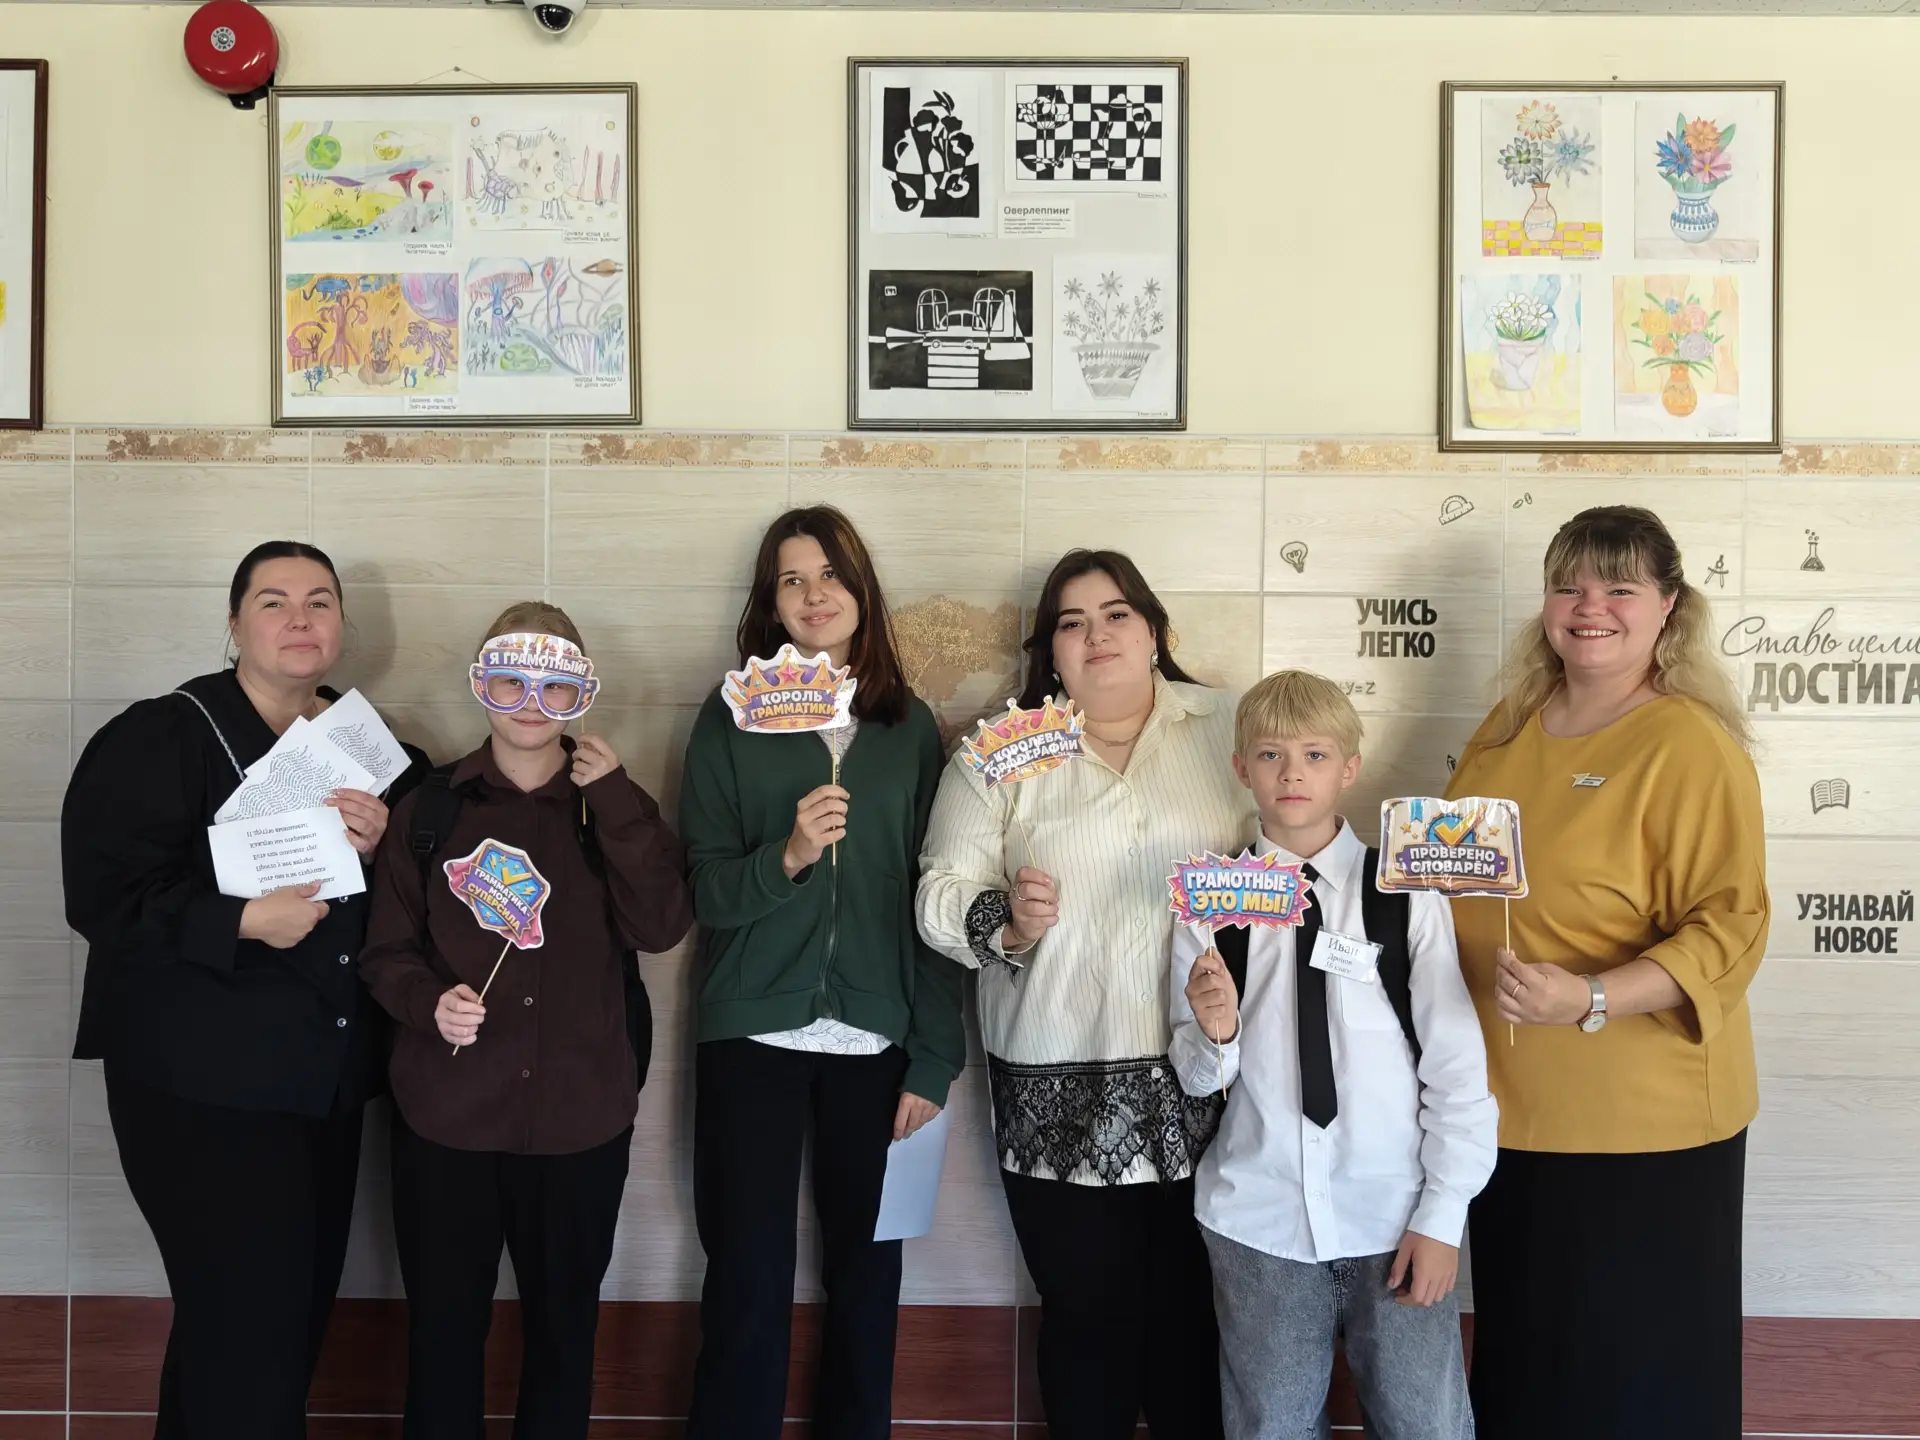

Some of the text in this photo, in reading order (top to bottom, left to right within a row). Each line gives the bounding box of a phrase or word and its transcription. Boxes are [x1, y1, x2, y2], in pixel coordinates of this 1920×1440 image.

[1003, 206, 1070, 216] Оверлеппинг
[1356, 598, 1438, 626] УЧИСЬ
[1721, 607, 1842, 657] Ставь
[1357, 631, 1436, 658] ЛЕГКО
[489, 652, 588, 676] Я ГРАМОТНЫЙ!
[761, 690, 823, 706] КОРОЛЬ
[750, 702, 835, 720] ГРАММАТИКИ
[993, 731, 1063, 761] КОРОЛЕВА
[1410, 847, 1495, 862] ПРОВЕРЕНО
[1410, 860, 1495, 876] СЛОВАРЁМ
[467, 883, 521, 931] СУПЕРСИЛА
[488, 887, 509, 906] МОЯ
[1194, 890, 1290, 914] ЭТО МЫ!
[1796, 889, 1914, 922] УЗНАВАЙ
[1328, 937, 1360, 957] Иван
[1814, 926, 1898, 953] НОВОЕ
